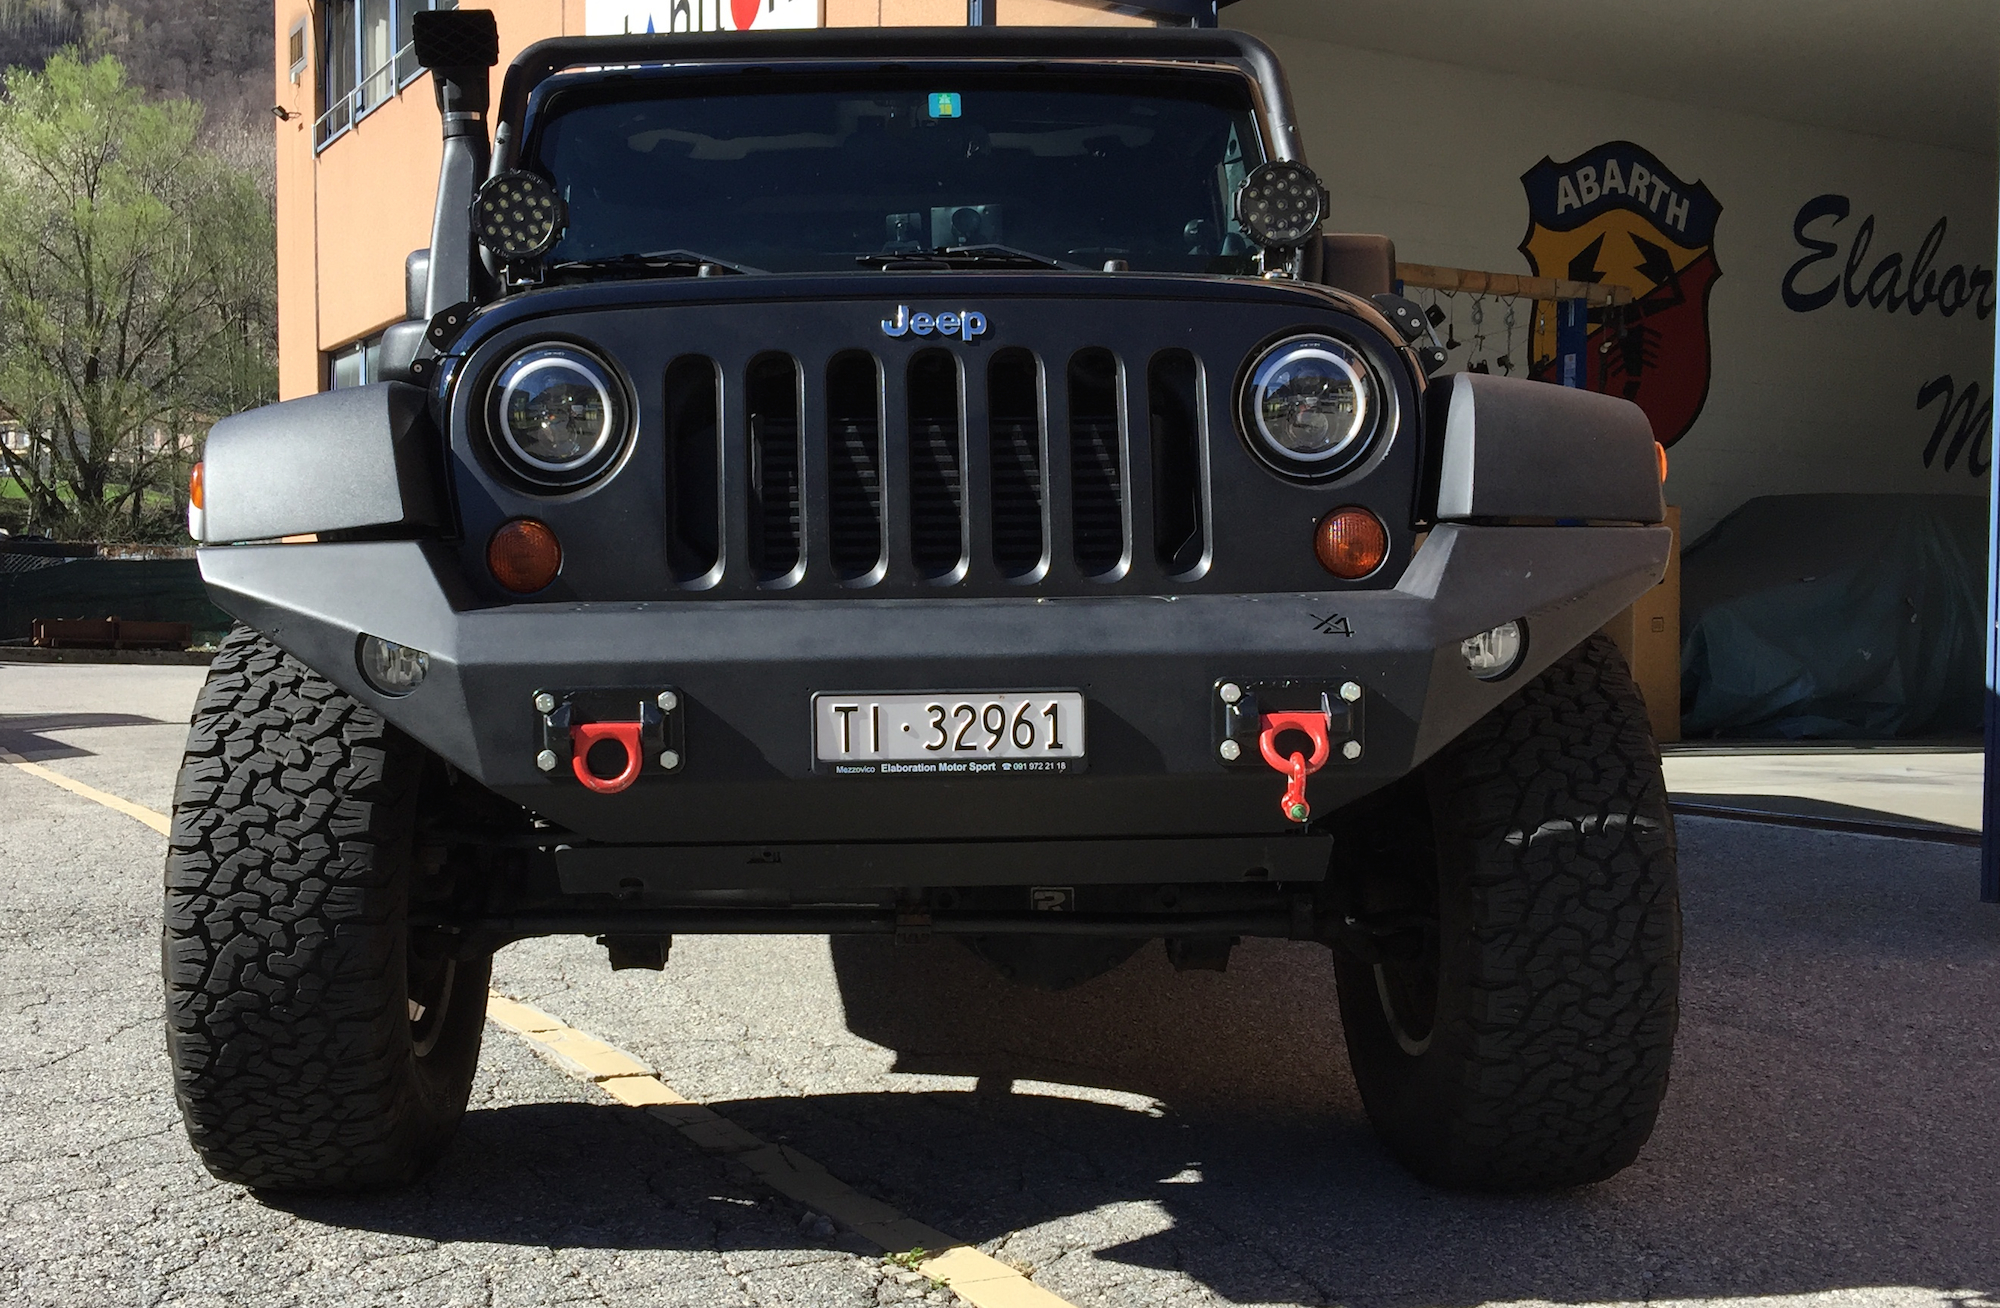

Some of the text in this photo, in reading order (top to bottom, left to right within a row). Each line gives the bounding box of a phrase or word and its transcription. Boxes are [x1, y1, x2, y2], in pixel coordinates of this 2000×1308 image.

[1556, 158, 1691, 233] ABARTH
[881, 305, 987, 341] Jeep
[836, 761, 1067, 774] Mezzovico Elaboration Motor Sport 091 972 21 18
